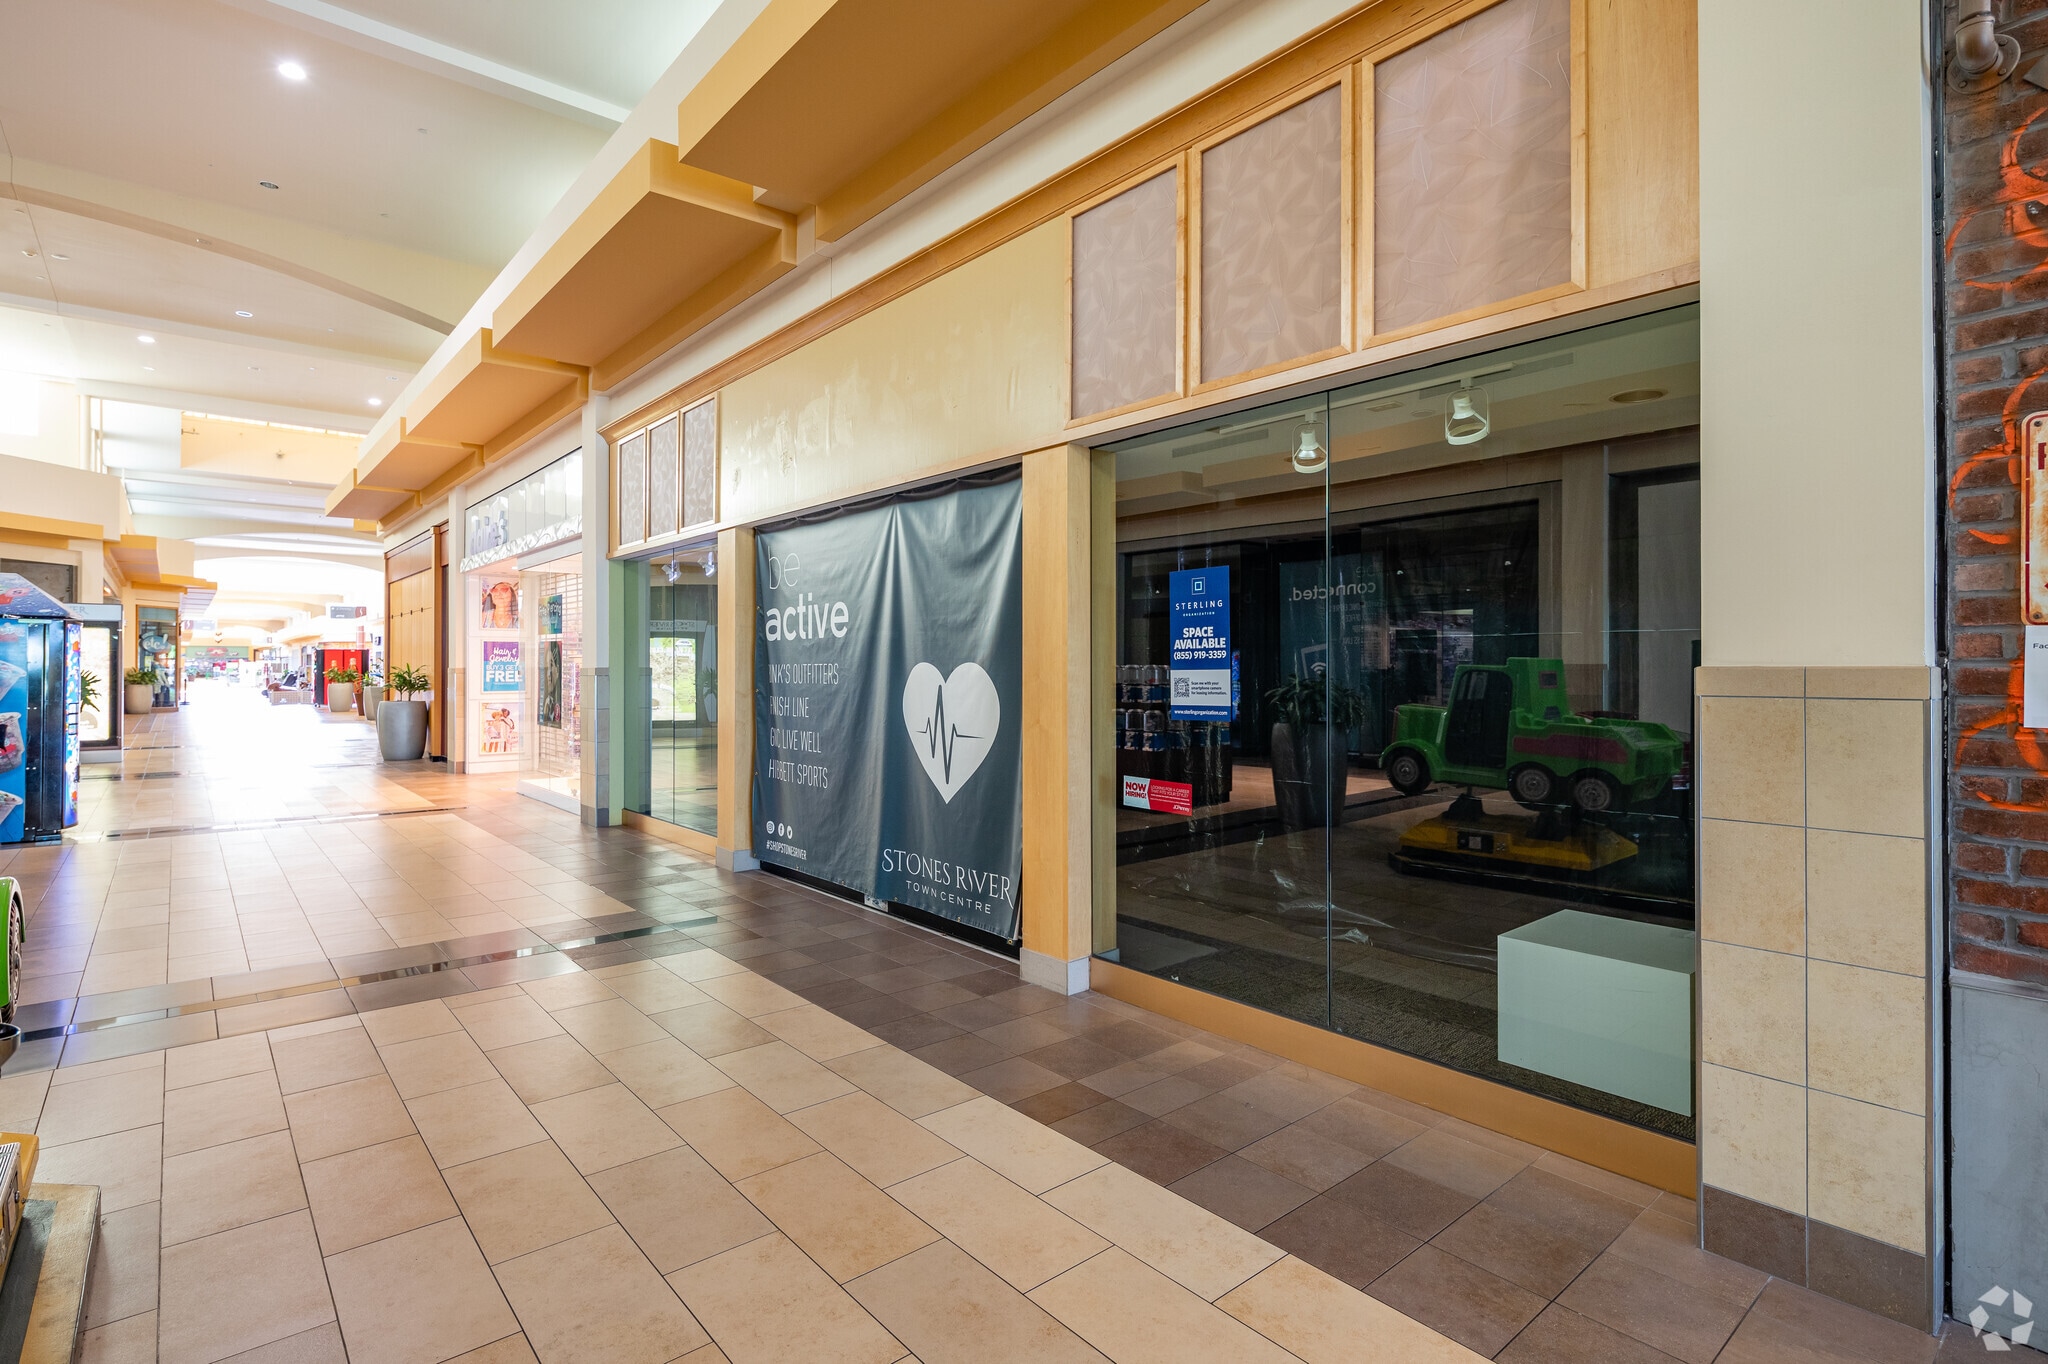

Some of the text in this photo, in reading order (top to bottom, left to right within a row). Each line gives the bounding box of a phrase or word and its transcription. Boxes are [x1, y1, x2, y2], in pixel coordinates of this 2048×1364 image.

[767, 546, 801, 589] be
[1175, 599, 1223, 610] STERLING
[765, 592, 849, 641] active
[1182, 626, 1214, 638] SPACE
[1174, 638, 1226, 649] AVAILABLE
[1173, 650, 1227, 661] (855) 919-3359
[486, 670, 523, 682] FREE
[792, 662, 839, 685] OUTFITTERS
[792, 697, 809, 718] LINE
[769, 727, 822, 753] GC LIVE WELL
[797, 763, 828, 789] SPORTS
[1125, 781, 1147, 791] NOW
[1125, 790, 1147, 799] HIRING!
[766, 839, 807, 861] #SHOPSTONESRIVER
[881, 848, 1014, 909] STONES RIVER
[905, 880, 992, 914] TOWN CENTRE
